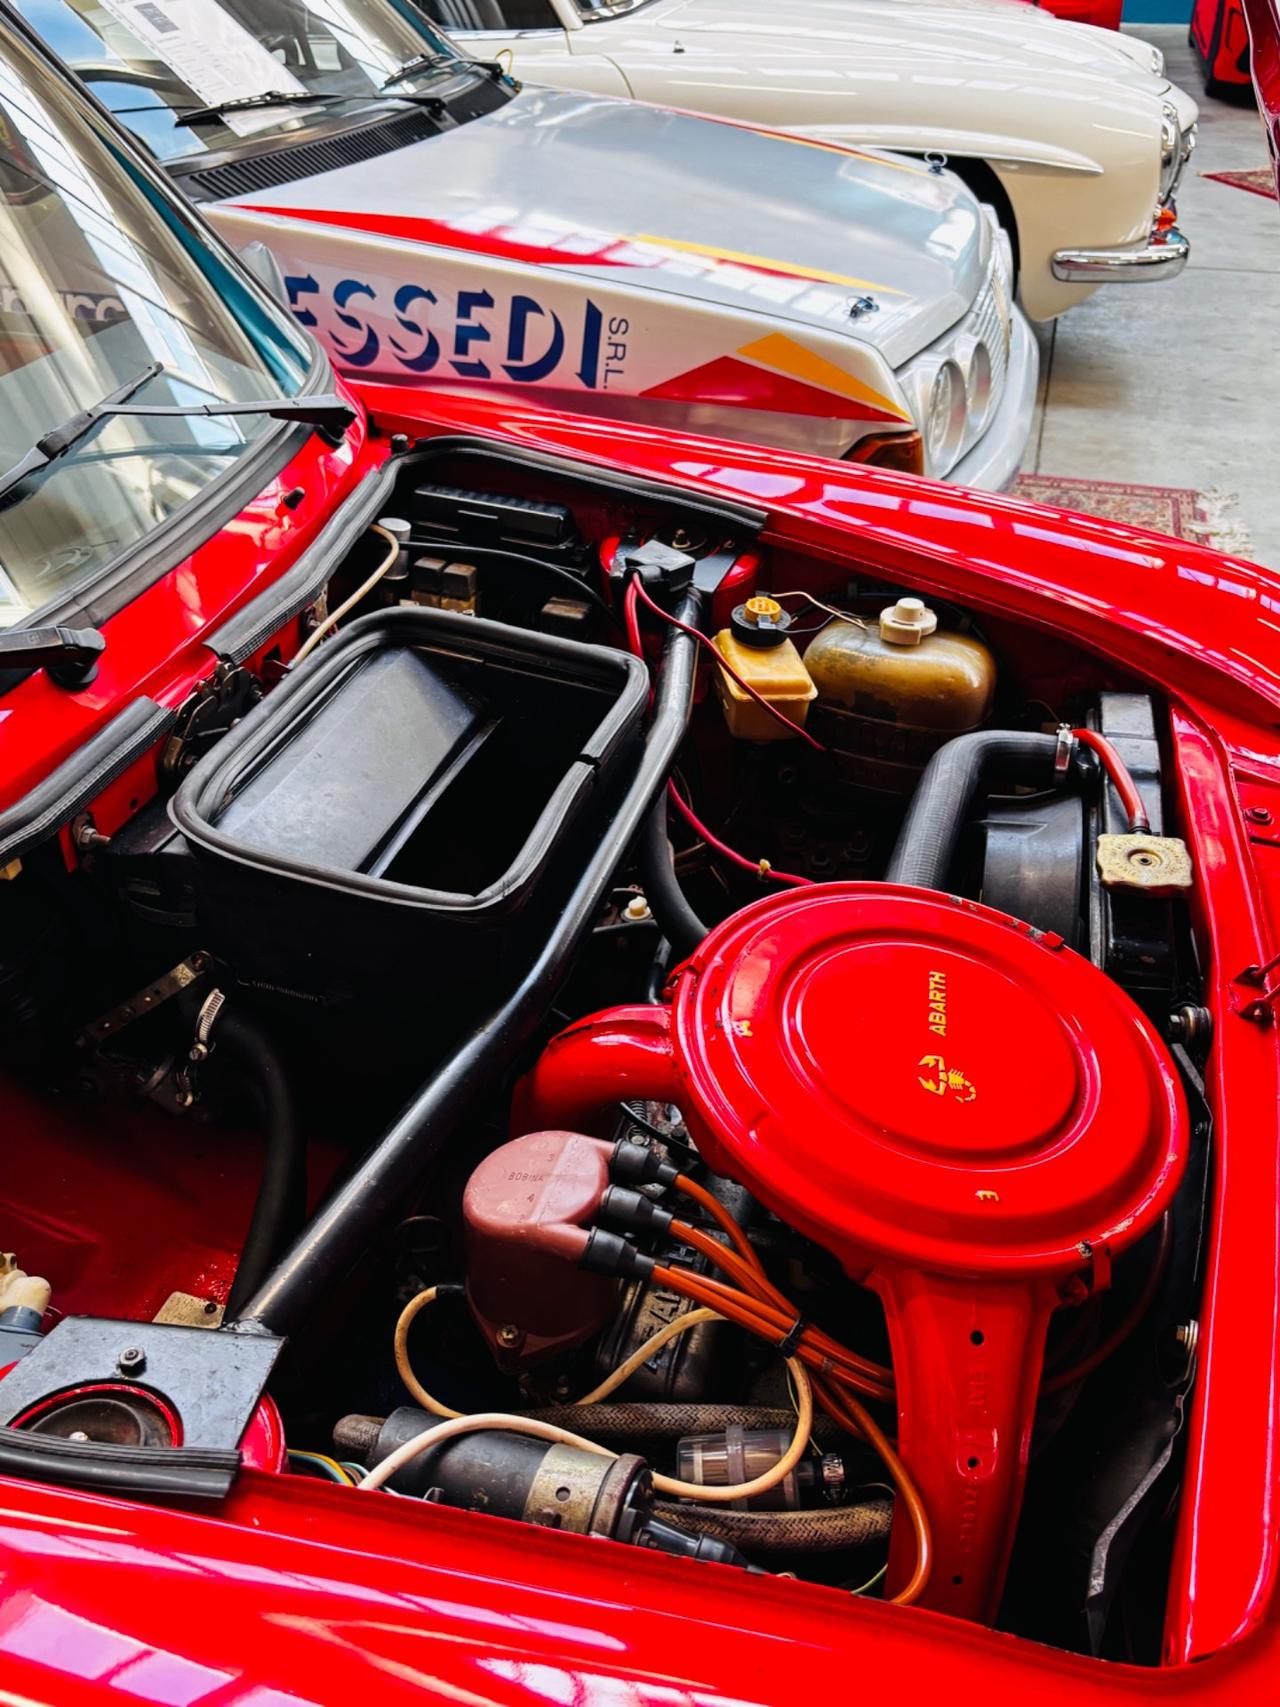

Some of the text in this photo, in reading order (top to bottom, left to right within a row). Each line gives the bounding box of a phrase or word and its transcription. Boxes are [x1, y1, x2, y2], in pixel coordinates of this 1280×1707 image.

[284, 273, 603, 389] ESSEDI
[603, 316, 629, 390] S.R.L.
[928, 970, 947, 1037] ABARTH
[508, 1171, 544, 1182] BOBINA
